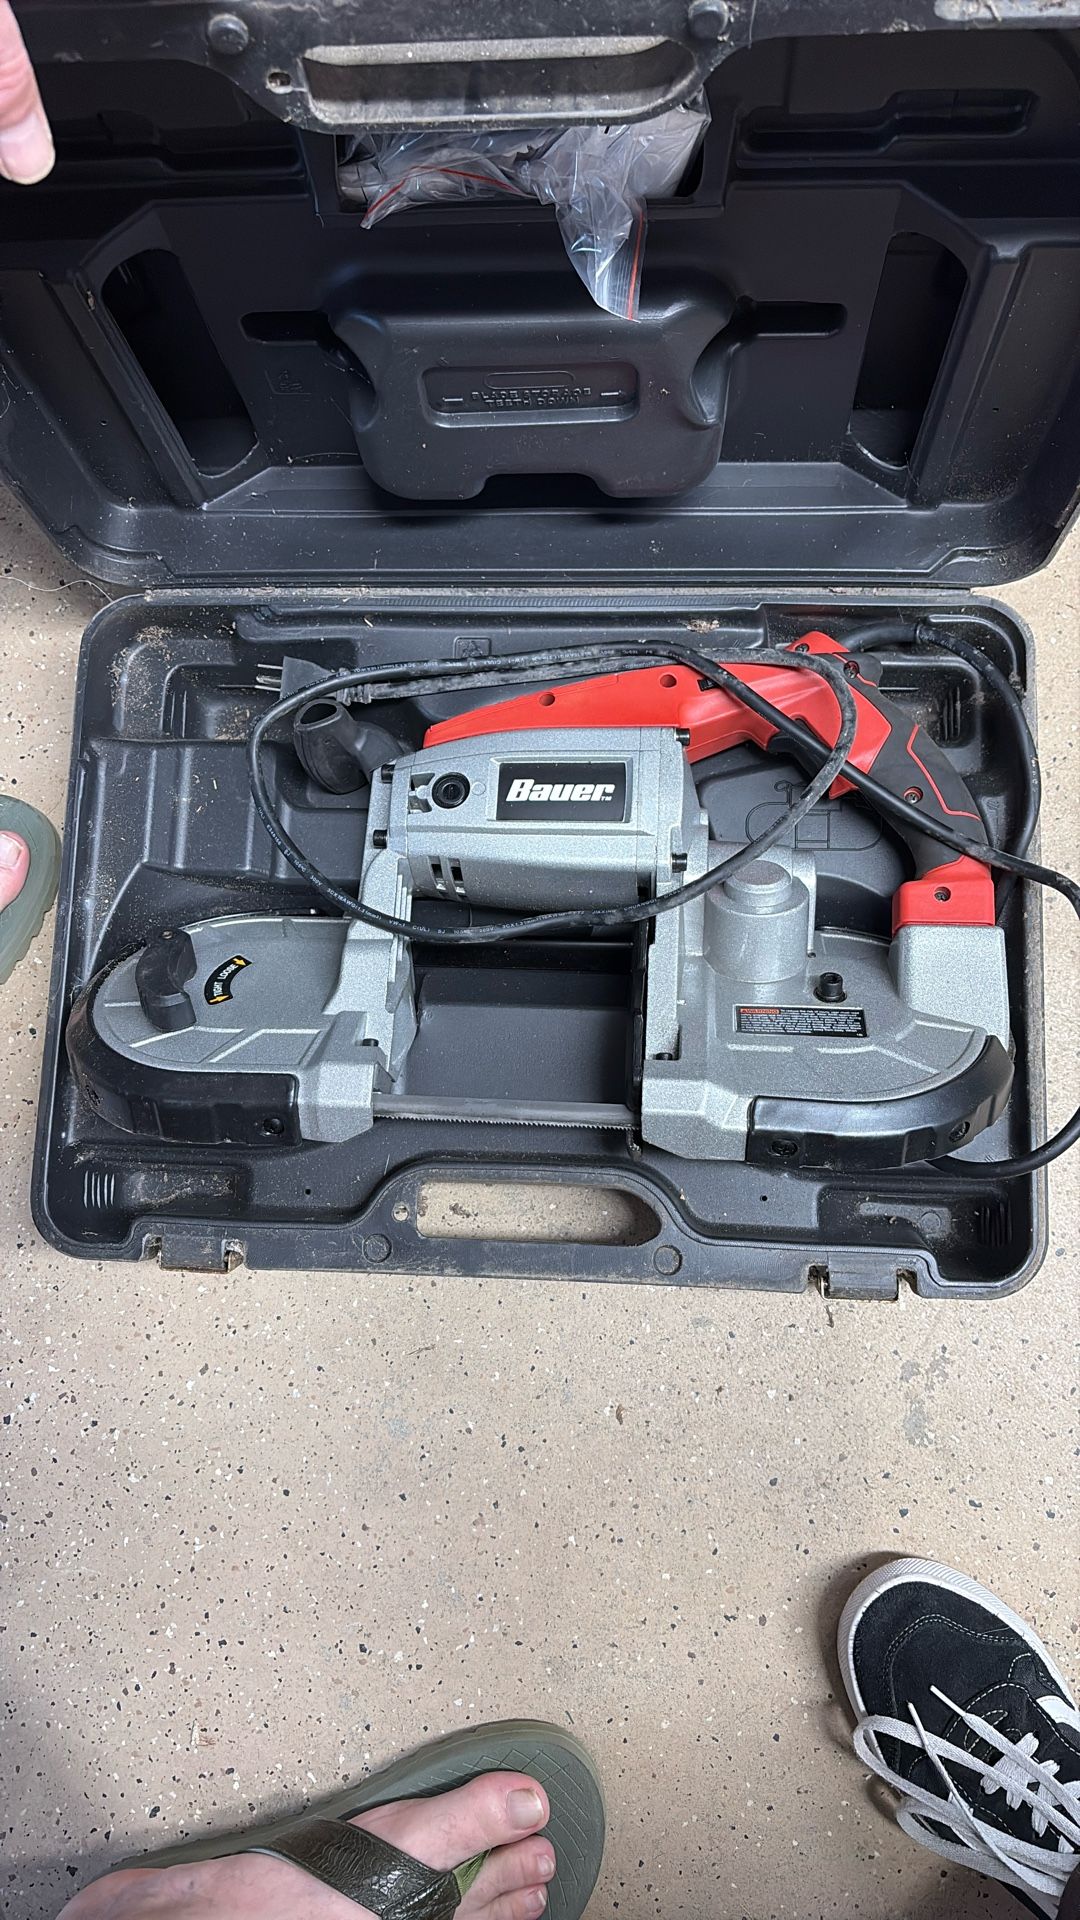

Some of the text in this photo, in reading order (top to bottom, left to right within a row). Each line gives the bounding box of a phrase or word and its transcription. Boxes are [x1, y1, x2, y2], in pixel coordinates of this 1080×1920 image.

[505, 778, 616, 802] Bauer
[213, 963, 239, 997] TIGHT LOOSE
